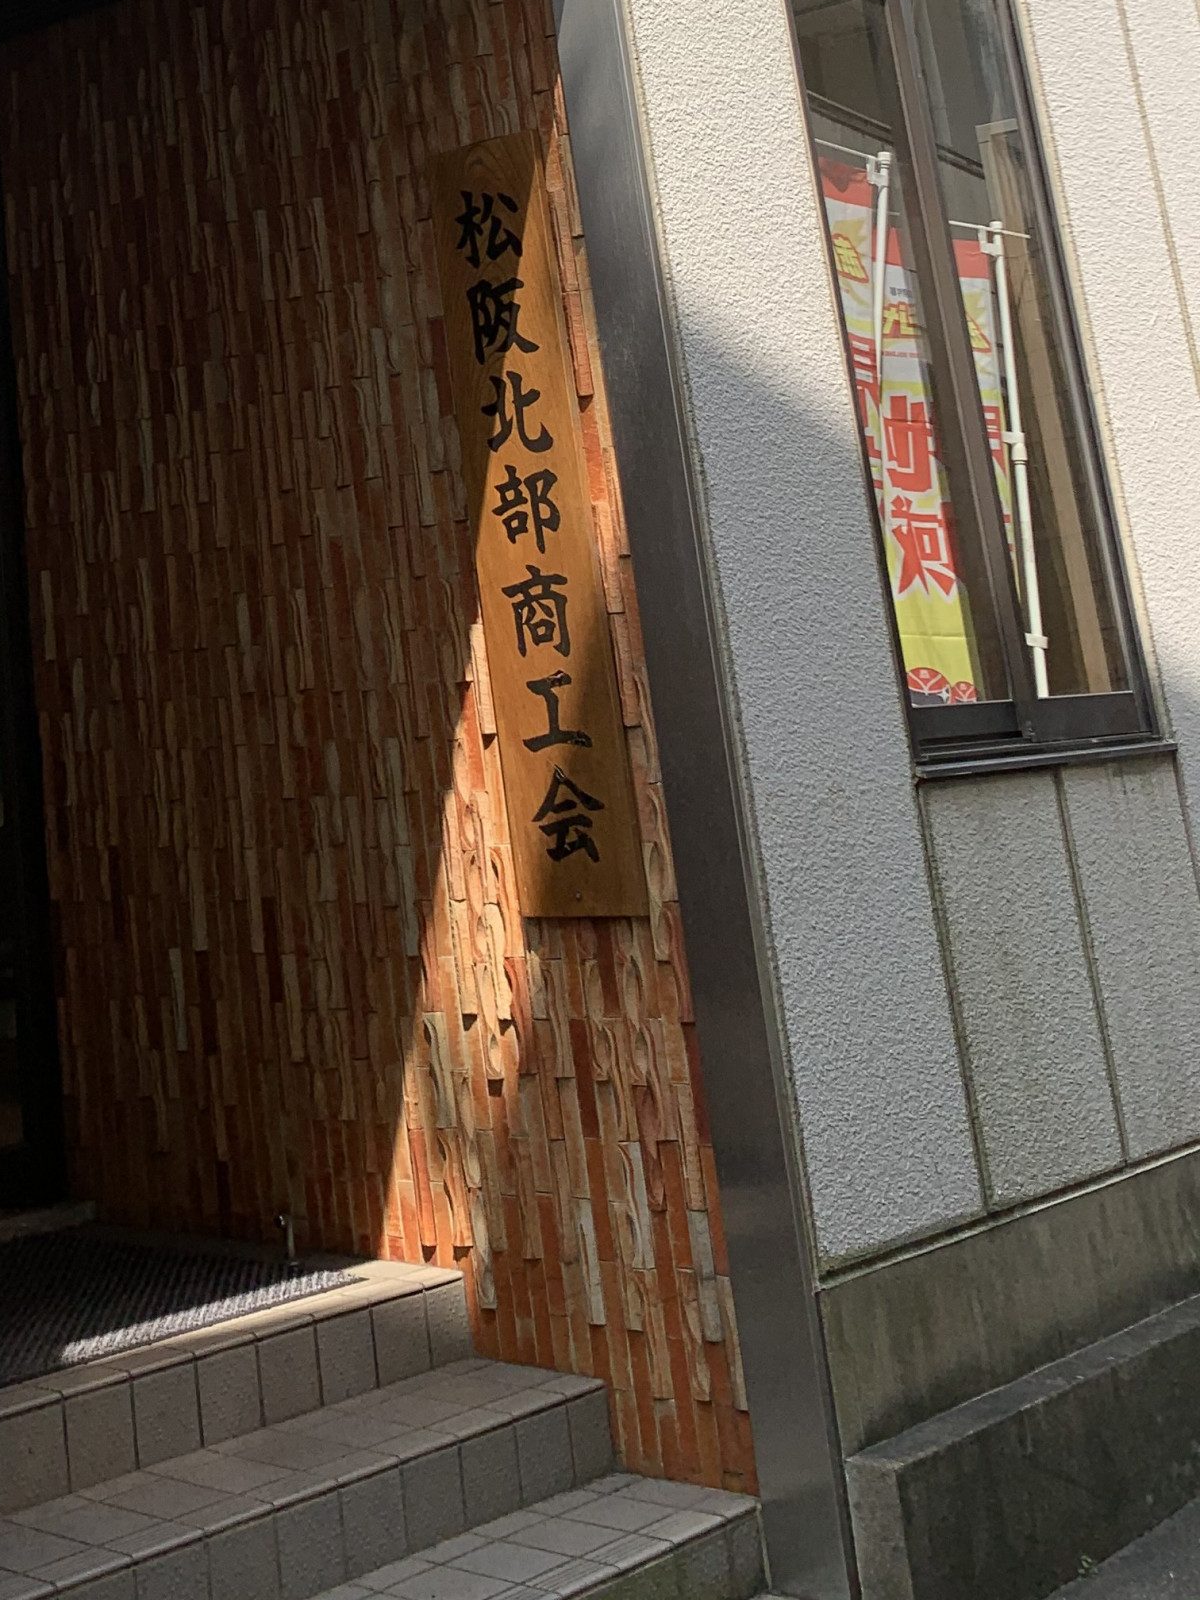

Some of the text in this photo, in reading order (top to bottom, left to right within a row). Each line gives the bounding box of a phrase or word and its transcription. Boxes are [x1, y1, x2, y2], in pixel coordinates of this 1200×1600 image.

[456, 190, 606, 865] 松阪北部商工会
